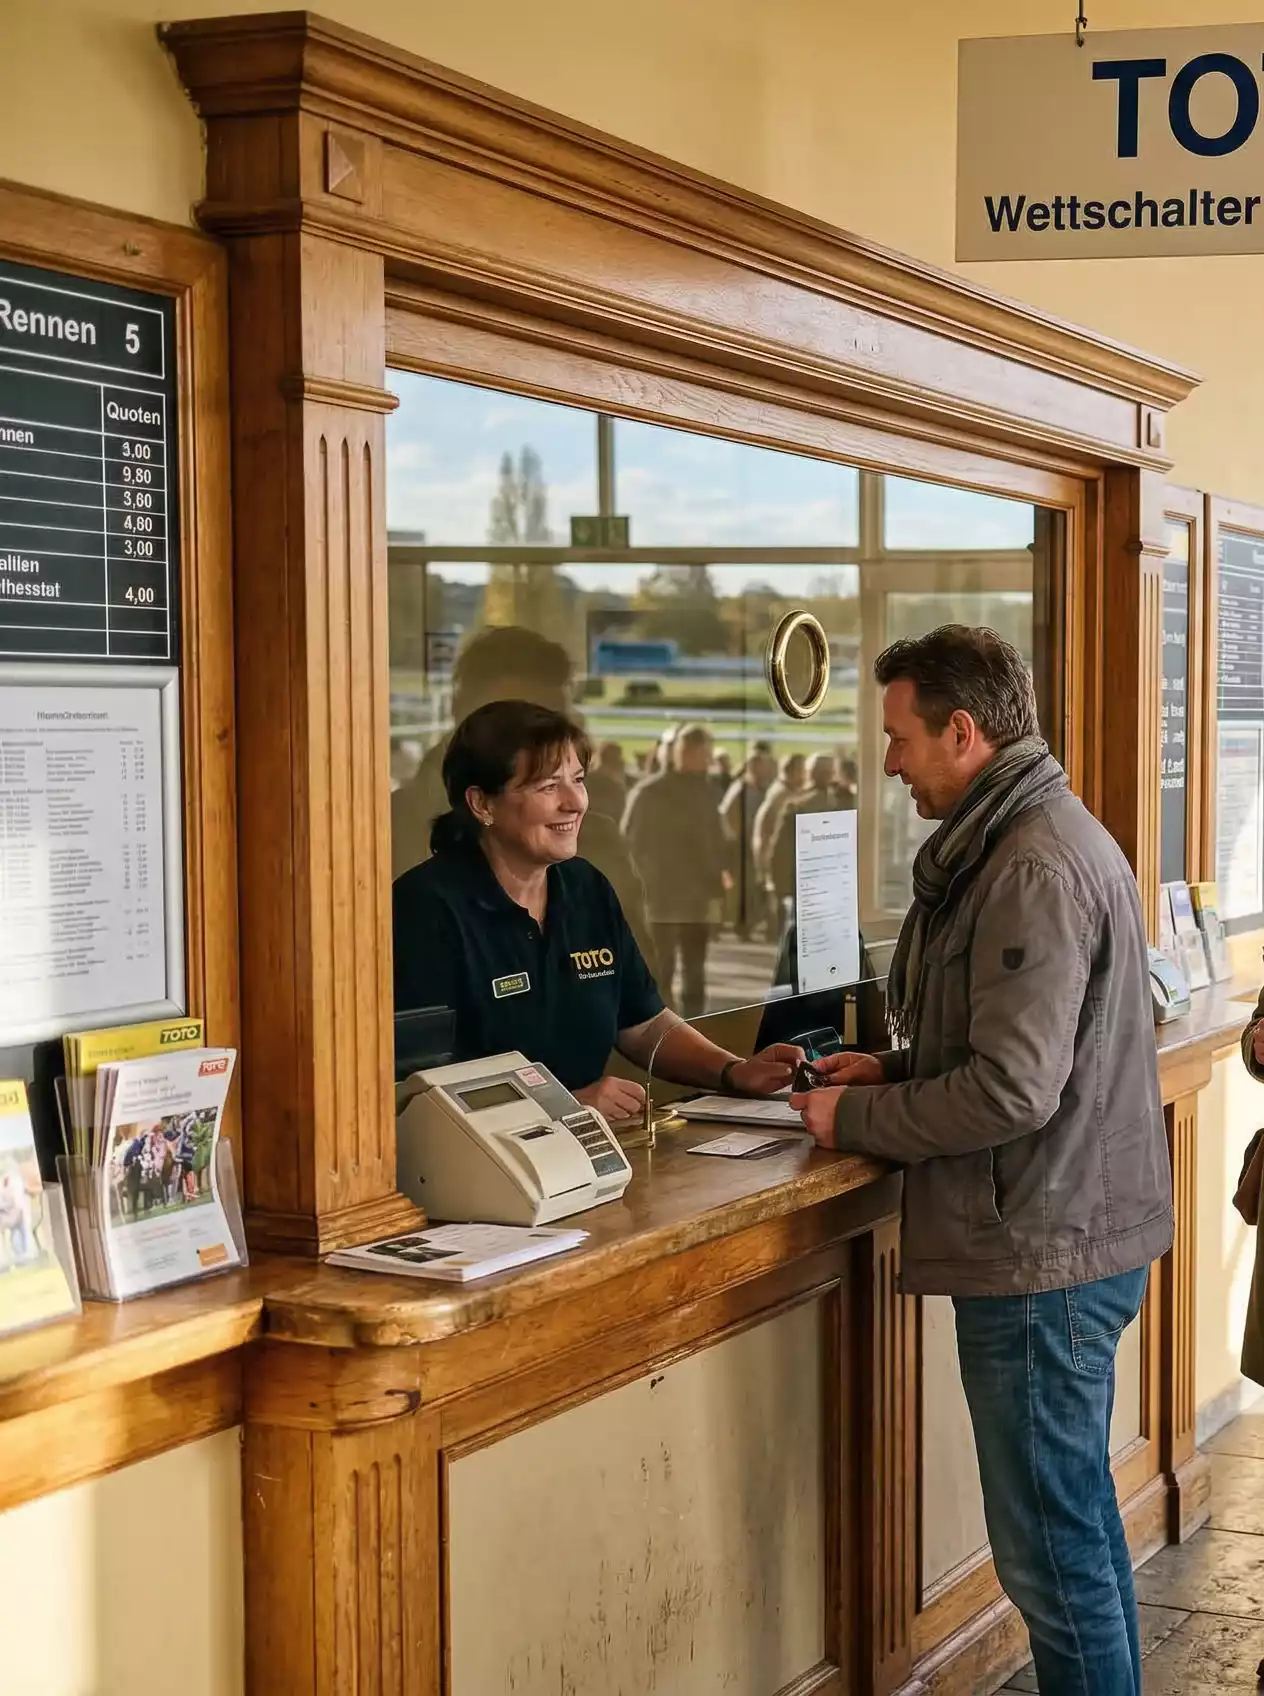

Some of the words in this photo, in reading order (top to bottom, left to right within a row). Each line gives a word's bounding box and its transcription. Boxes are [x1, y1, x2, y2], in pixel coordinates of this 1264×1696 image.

[984, 189, 1261, 232] Wettschalter
[0, 298, 97, 345] Rennen
[125, 323, 140, 354] 5
[106, 401, 161, 426] Quoten
[122, 466, 152, 485] 9,80
[125, 586, 154, 605] 4,00
[570, 948, 614, 970] TOTO
[162, 1027, 197, 1042] TOTO
